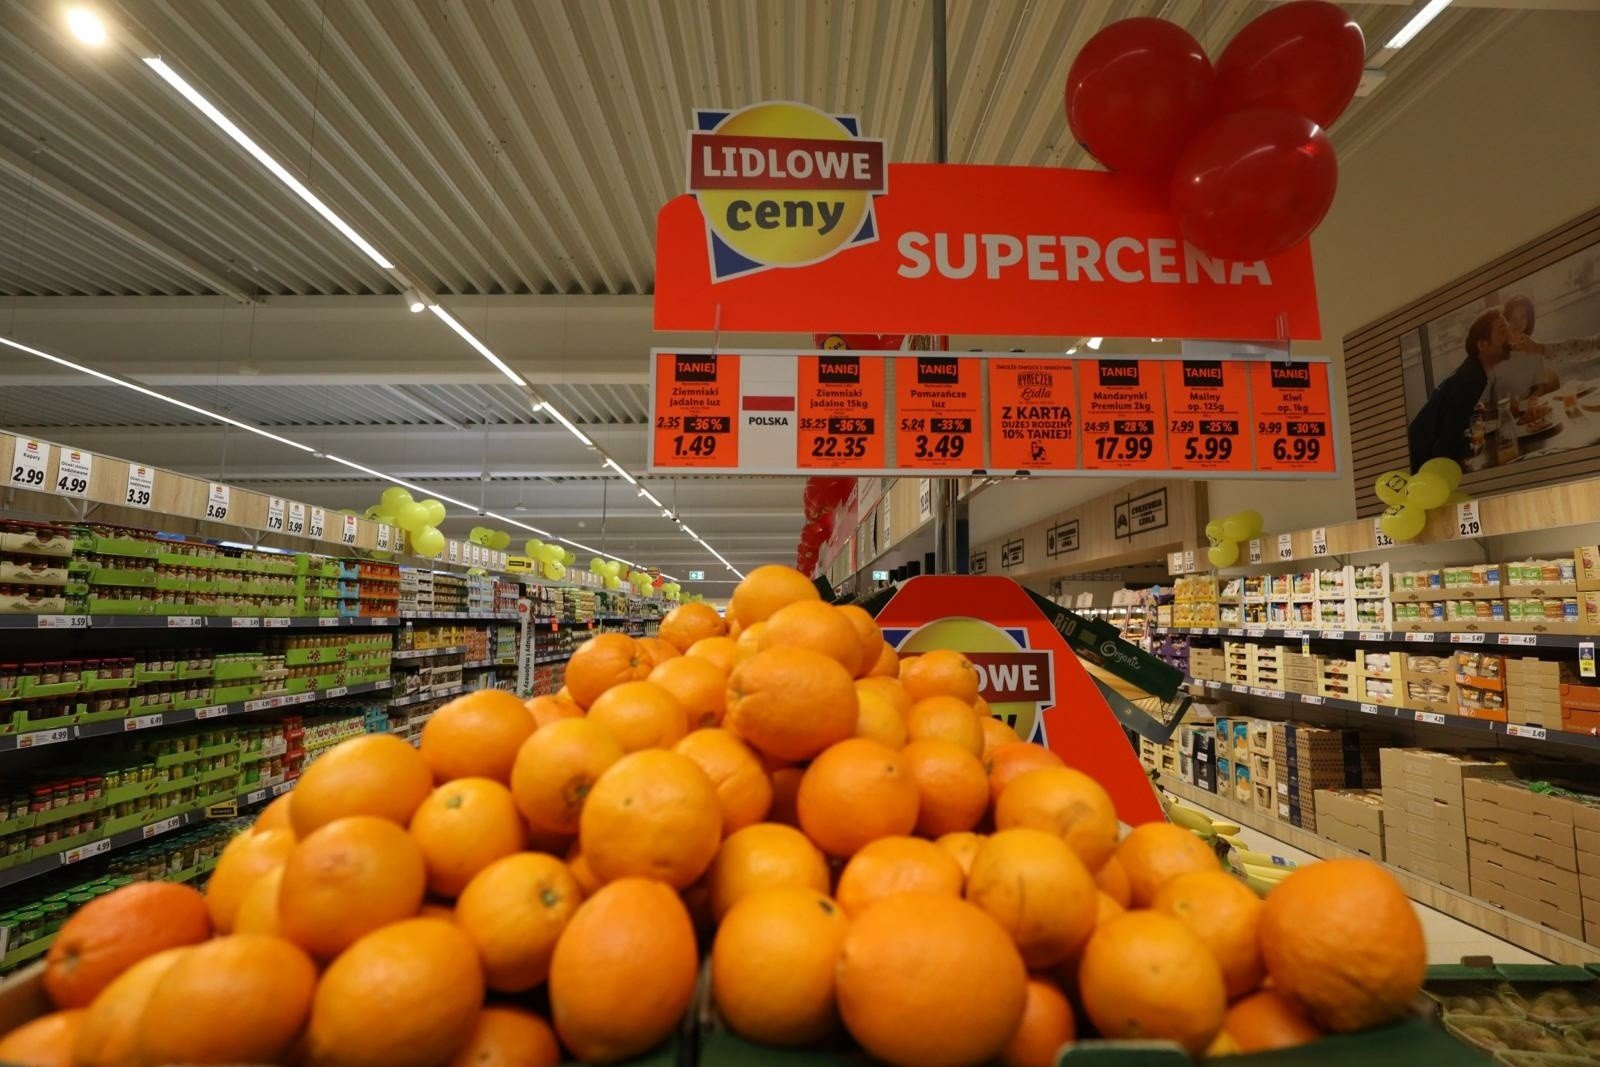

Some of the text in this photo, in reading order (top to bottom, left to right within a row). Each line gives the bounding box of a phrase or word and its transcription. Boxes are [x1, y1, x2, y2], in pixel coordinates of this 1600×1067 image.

[702, 145, 871, 181] LIDLOWE
[726, 198, 846, 237] ceny
[678, 363, 715, 374] TANIEJ
[820, 364, 858, 375] TANIEJ
[920, 365, 957, 376] TANIEJ
[1101, 367, 1137, 379] TANIEJ
[1185, 368, 1221, 379] TANIEJ
[1272, 369, 1308, 380] TANIEJ
[672, 387, 719, 395] Ziemniaki
[816, 389, 862, 397] Ziemniaki
[910, 389, 967, 398] Pomarańcze
[1093, 392, 1148, 401] Mandarynki
[670, 398, 721, 407] jadalne luz
[1189, 392, 1220, 402] Maliny
[1282, 393, 1302, 402] Kiwi
[810, 399, 868, 409] jadalne 15kg
[931, 400, 946, 408] luz
[1091, 402, 1150, 411] Premium 2kg
[1204, 402, 1224, 412] 125g
[1294, 404, 1309, 413] 1kg
[1002, 406, 1072, 422] Z KARTĄ
[656, 416, 681, 428] 2.35
[748, 416, 789, 426] POLSKA
[800, 418, 828, 430] 35.25
[901, 418, 925, 431] 5.24
[1002, 420, 1072, 428] DUŻEJ RODZINY
[1084, 421, 1110, 432] 24.99
[1170, 420, 1195, 432] 7.99
[1258, 421, 1282, 433] 9.99
[1002, 429, 1072, 439] 10% TANIEJ!
[673, 435, 717, 457] 1.49
[811, 436, 868, 457] 22.35
[914, 435, 965, 458] 3.49
[1095, 437, 1153, 460] 17.99
[1184, 437, 1233, 460] 5.99
[1273, 438, 1321, 461] 6.99
[13, 466, 45, 485] 2.99
[58, 476, 87, 493] 4.99
[127, 488, 150, 505] 3.39
[207, 505, 227, 519] 3.69
[268, 516, 282, 529] 1.79
[288, 521, 302, 533] 3.99
[1460, 521, 1479, 535] 2.19
[310, 525, 323, 537] 5.70
[1314, 544, 1326, 555] 3.29
[71, 617, 86, 626] 3.59
[52, 731, 67, 740] 4.99
[167, 818, 179, 828] 5.99
[97, 838, 110, 851] 4.99
